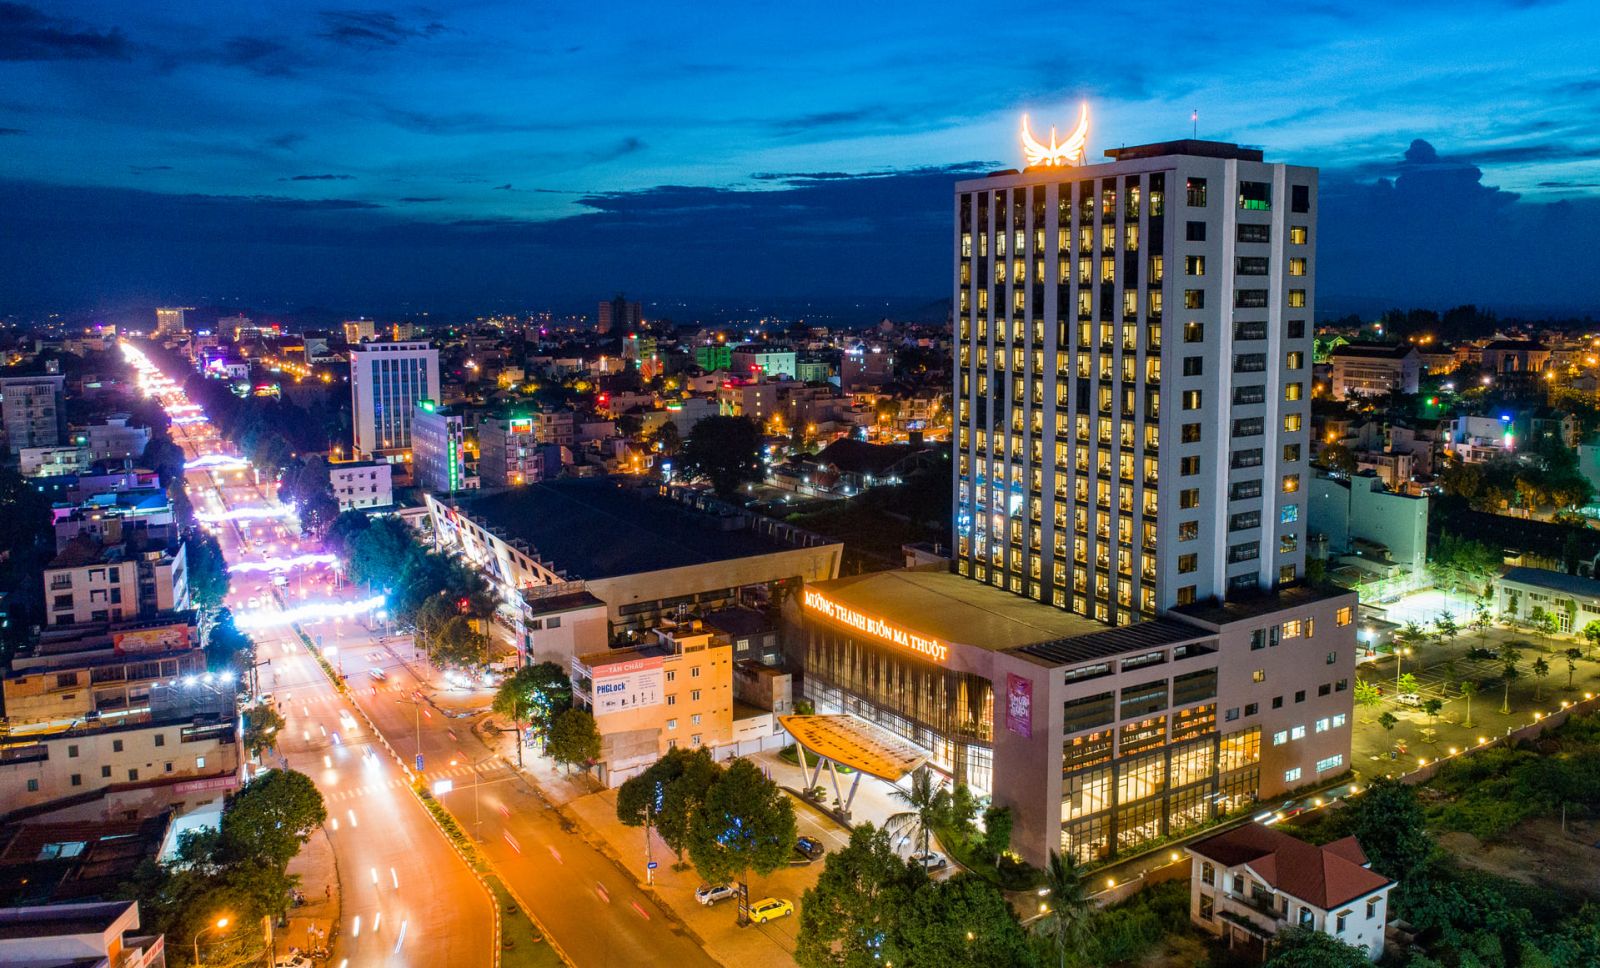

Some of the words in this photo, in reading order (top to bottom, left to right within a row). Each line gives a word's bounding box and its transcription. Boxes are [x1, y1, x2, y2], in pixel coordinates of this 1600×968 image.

[834, 605, 866, 631] THANH
[867, 620, 892, 640] BUÔN
[893, 629, 909, 647] MA
[910, 635, 947, 661] THUỘT
